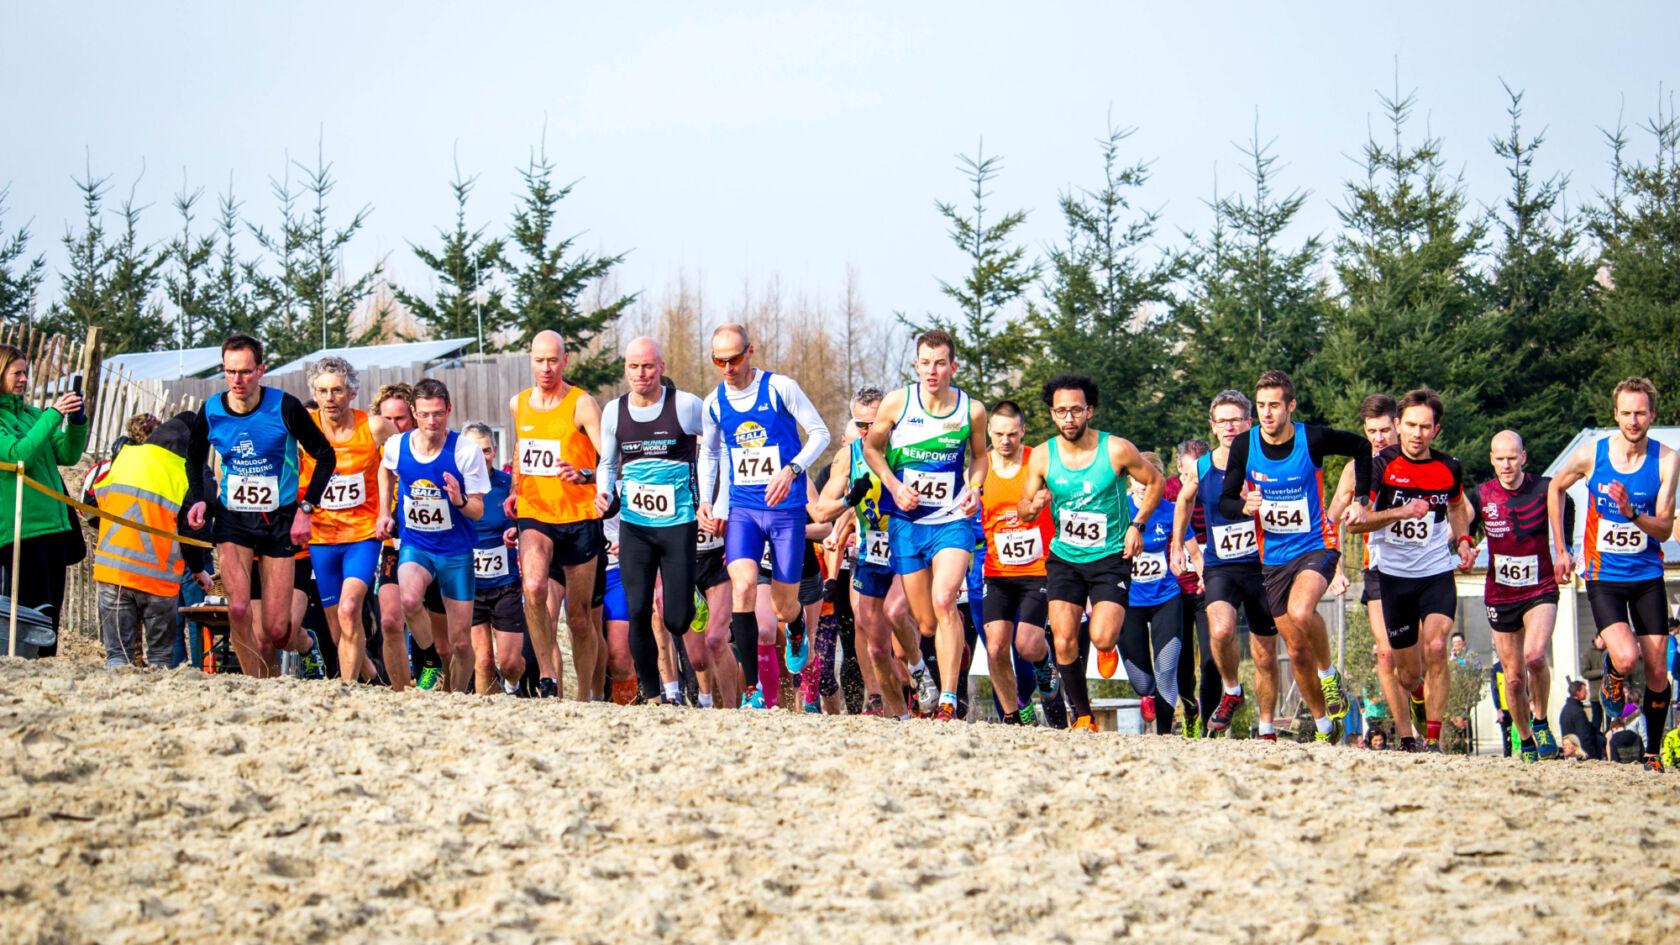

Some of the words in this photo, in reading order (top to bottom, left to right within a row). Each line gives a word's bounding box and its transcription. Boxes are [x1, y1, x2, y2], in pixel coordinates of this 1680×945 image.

[736, 430, 768, 443] ISALA
[523, 448, 554, 468] 470
[910, 449, 959, 461] EMPOWER
[738, 457, 775, 477] 474
[233, 485, 272, 505] 452
[323, 483, 360, 503] 475
[410, 487, 441, 498] ISALA
[910, 480, 948, 499] 445
[632, 492, 668, 512] 460
[408, 508, 444, 525] 464
[1264, 509, 1304, 527] 454
[1065, 520, 1100, 540] 443
[1390, 520, 1428, 540] 463
[1602, 530, 1642, 547] 455
[872, 540, 891, 559] 47
[1002, 538, 1036, 559] 457
[1220, 530, 1257, 552] 472
[474, 555, 503, 572] 473
[1131, 560, 1162, 577] 422
[1500, 564, 1531, 580] 461
